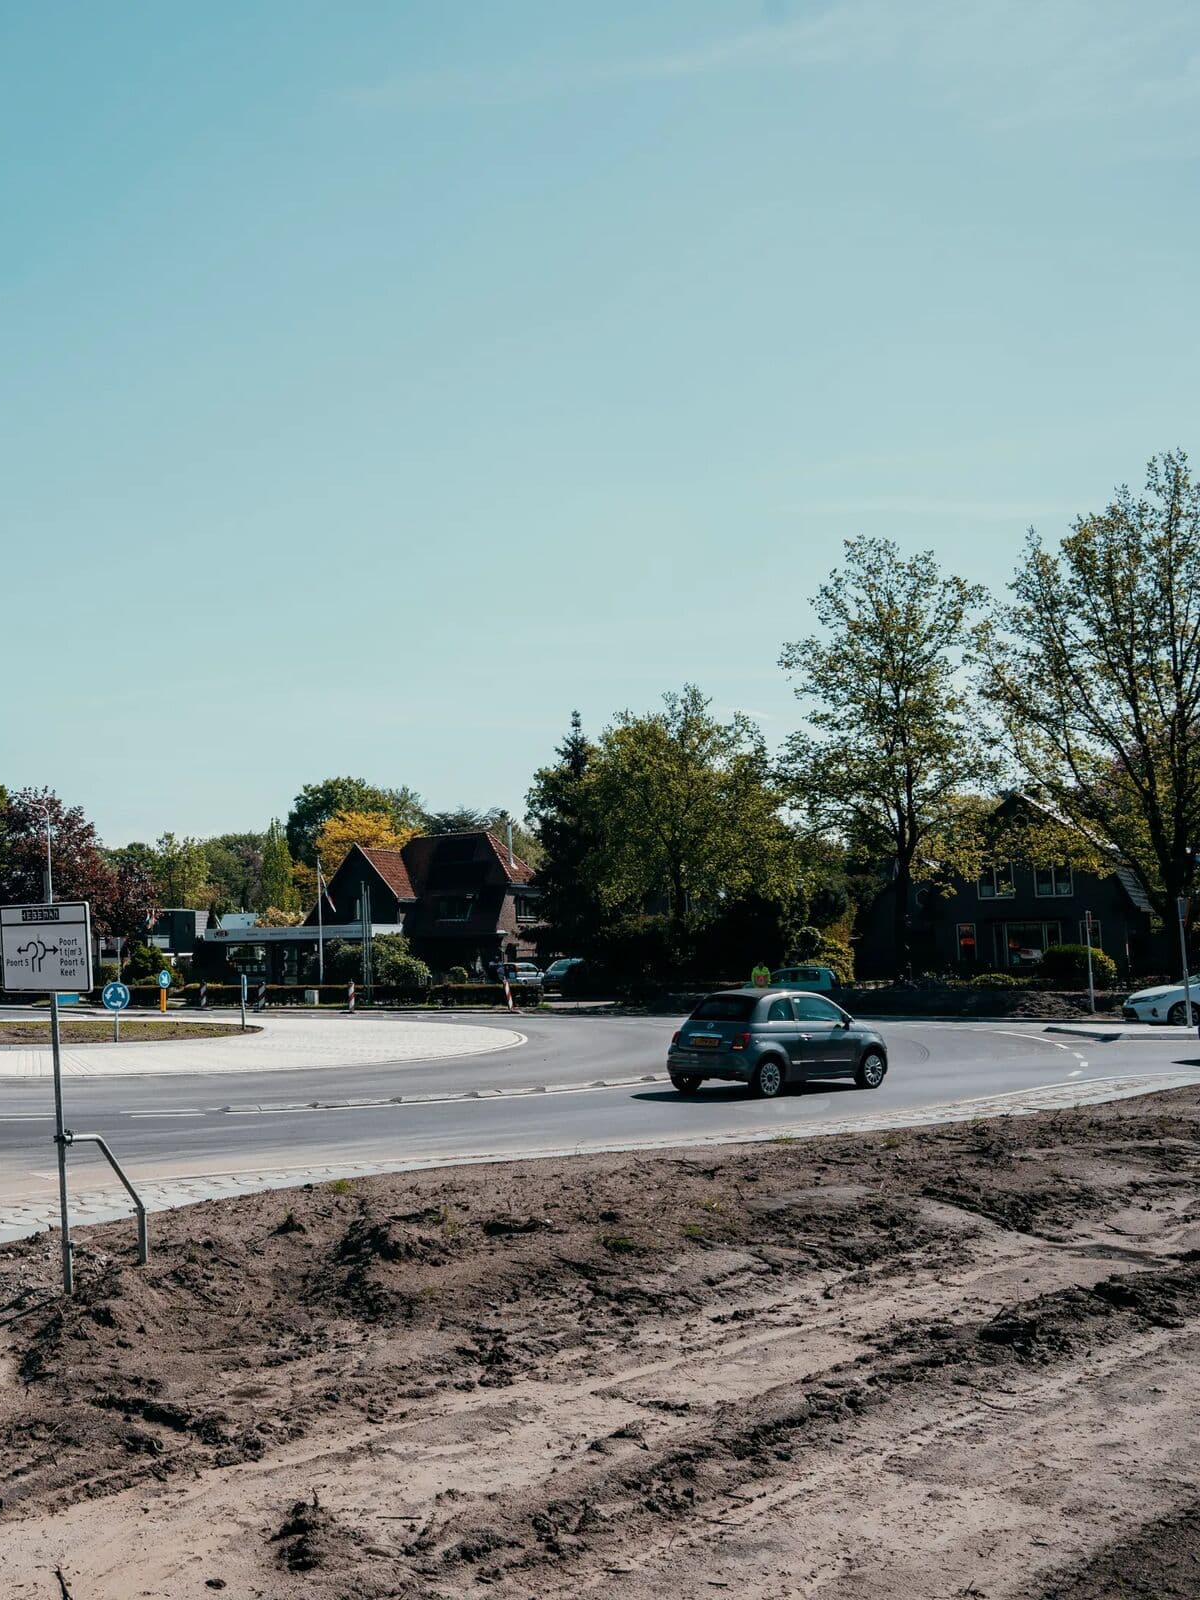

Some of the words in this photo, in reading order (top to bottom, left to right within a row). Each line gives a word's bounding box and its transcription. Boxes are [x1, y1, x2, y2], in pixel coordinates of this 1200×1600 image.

[59, 938, 78, 946] Poort
[6, 959, 24, 967] Poort
[60, 958, 79, 966] Poort
